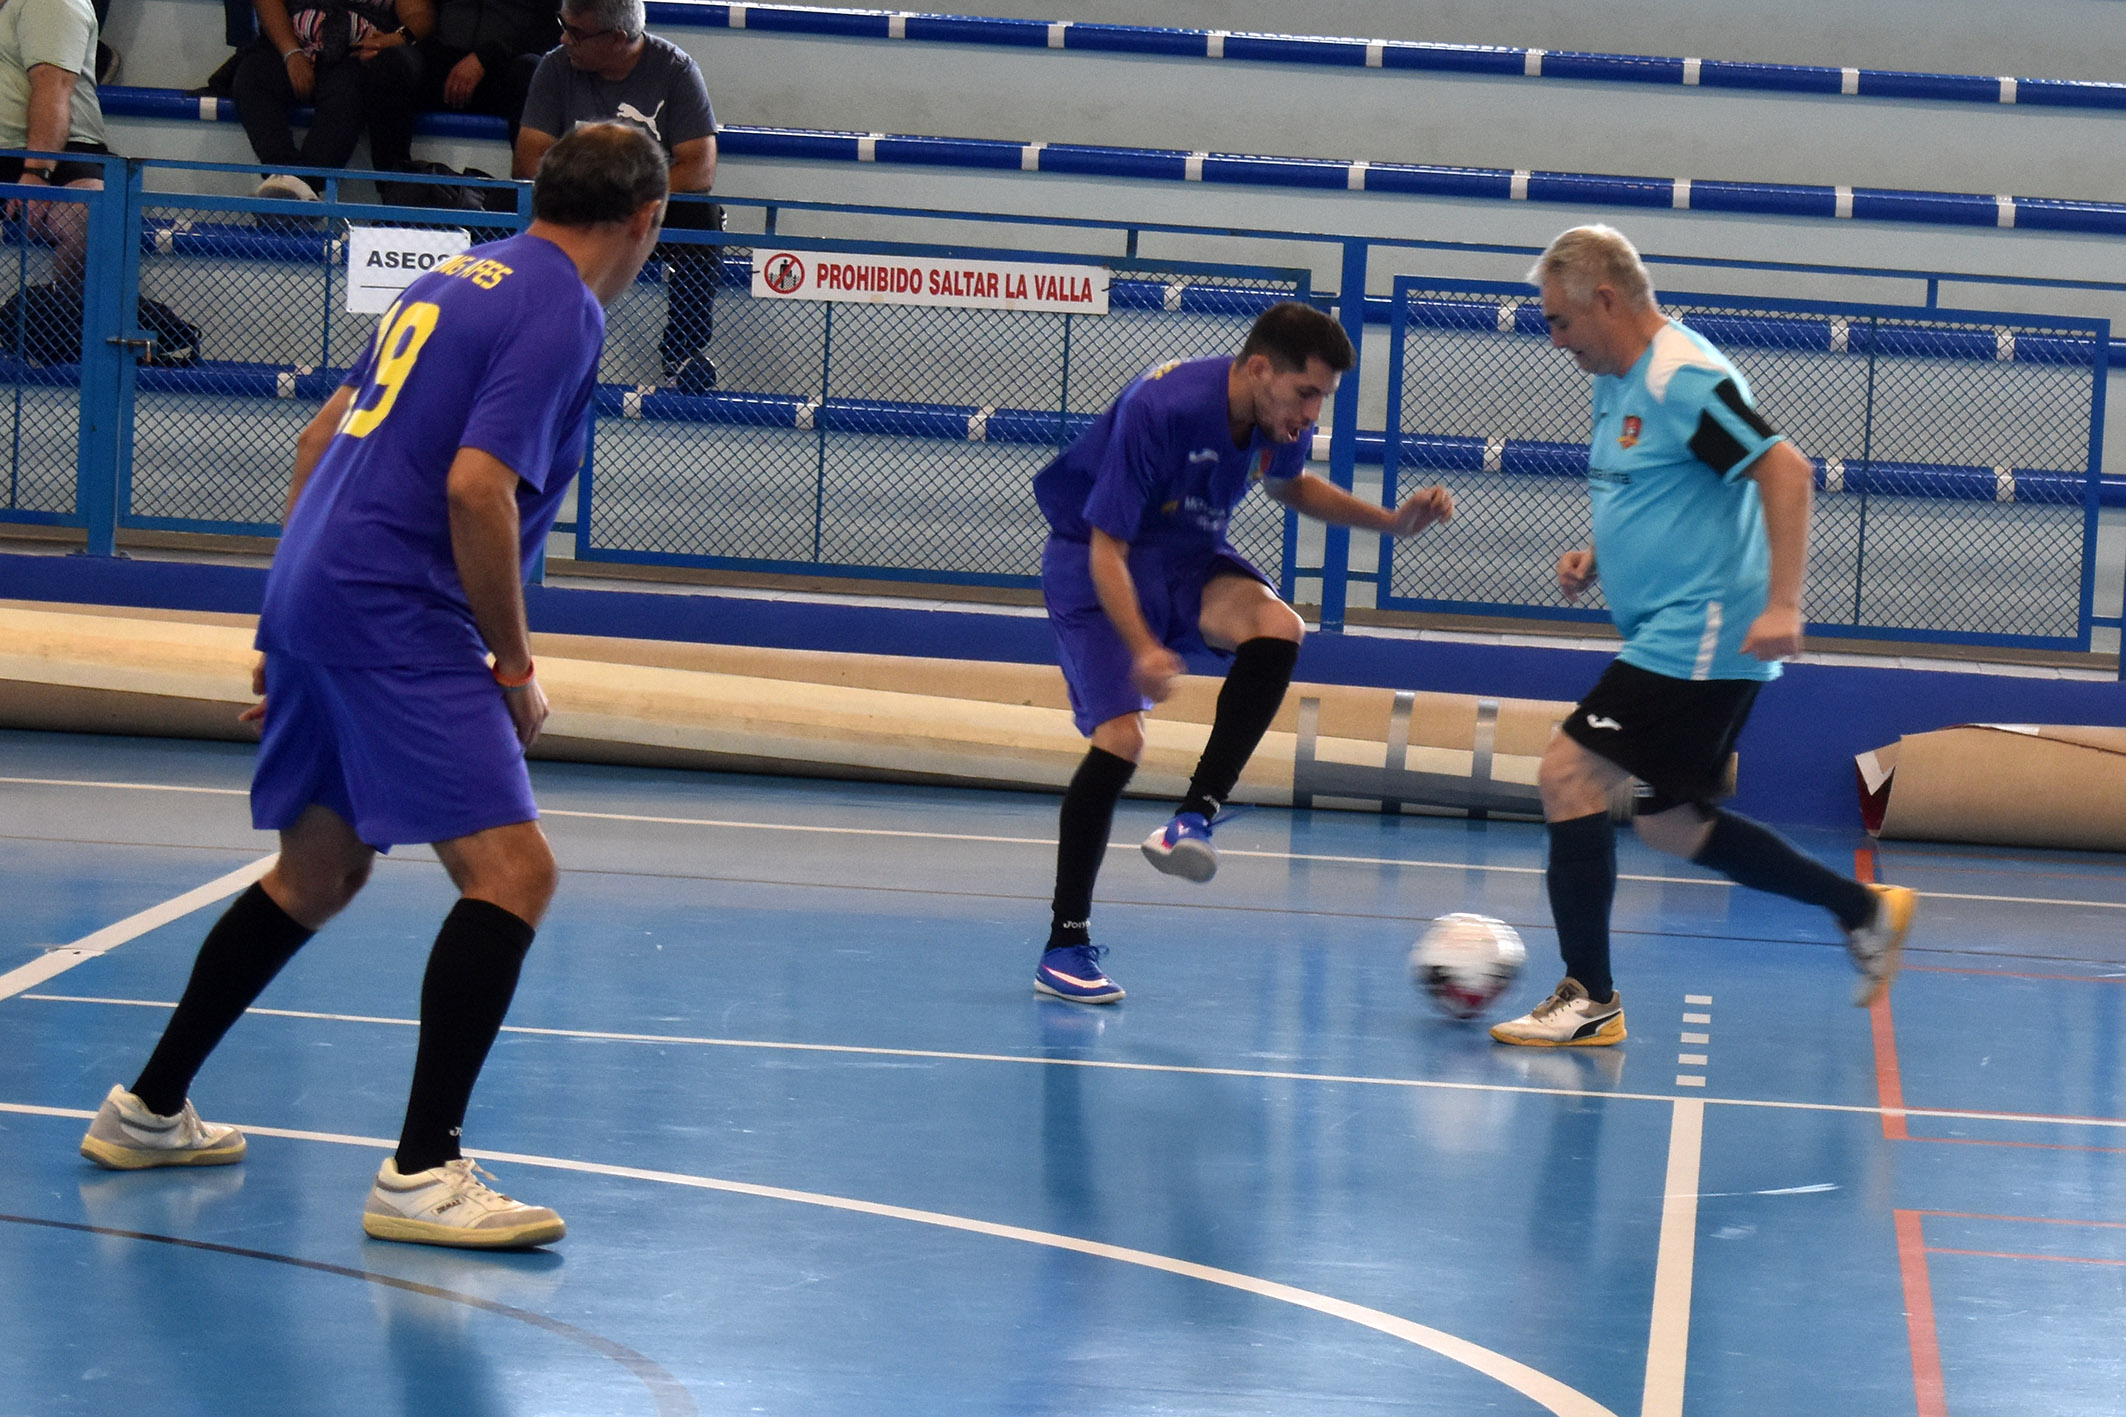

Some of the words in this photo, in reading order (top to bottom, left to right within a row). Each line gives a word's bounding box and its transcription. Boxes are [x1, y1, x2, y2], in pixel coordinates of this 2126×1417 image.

[816, 263, 924, 295] PROHIBIDO
[928, 268, 999, 298] SALTAR
[1005, 273, 1028, 300] LA
[1033, 274, 1093, 303] VALLA
